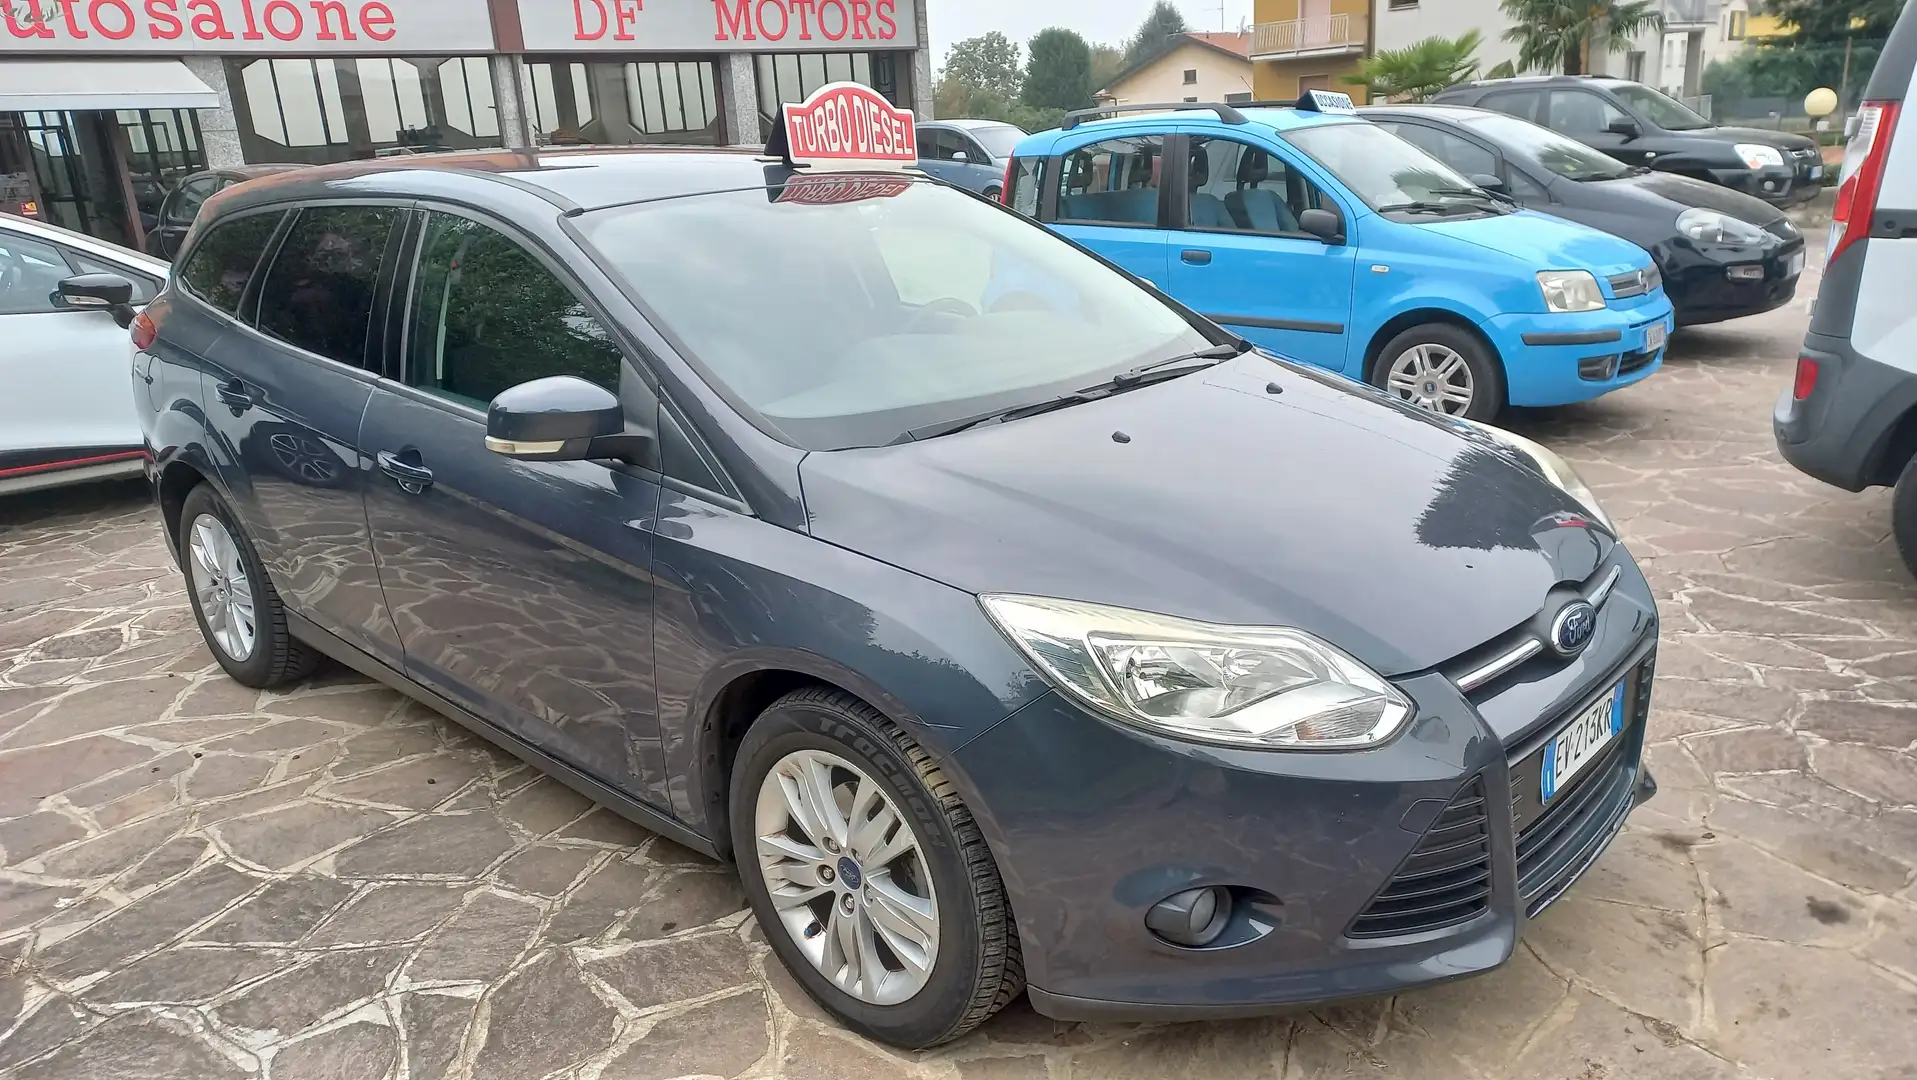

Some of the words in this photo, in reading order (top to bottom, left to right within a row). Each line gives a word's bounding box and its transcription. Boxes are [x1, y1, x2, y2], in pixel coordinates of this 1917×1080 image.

[573, 0, 643, 41] DF
[713, 0, 897, 41] MOTORS
[791, 94, 853, 153] TURBO
[853, 95, 913, 154] DIESEL
[1567, 613, 1590, 644] Ford
